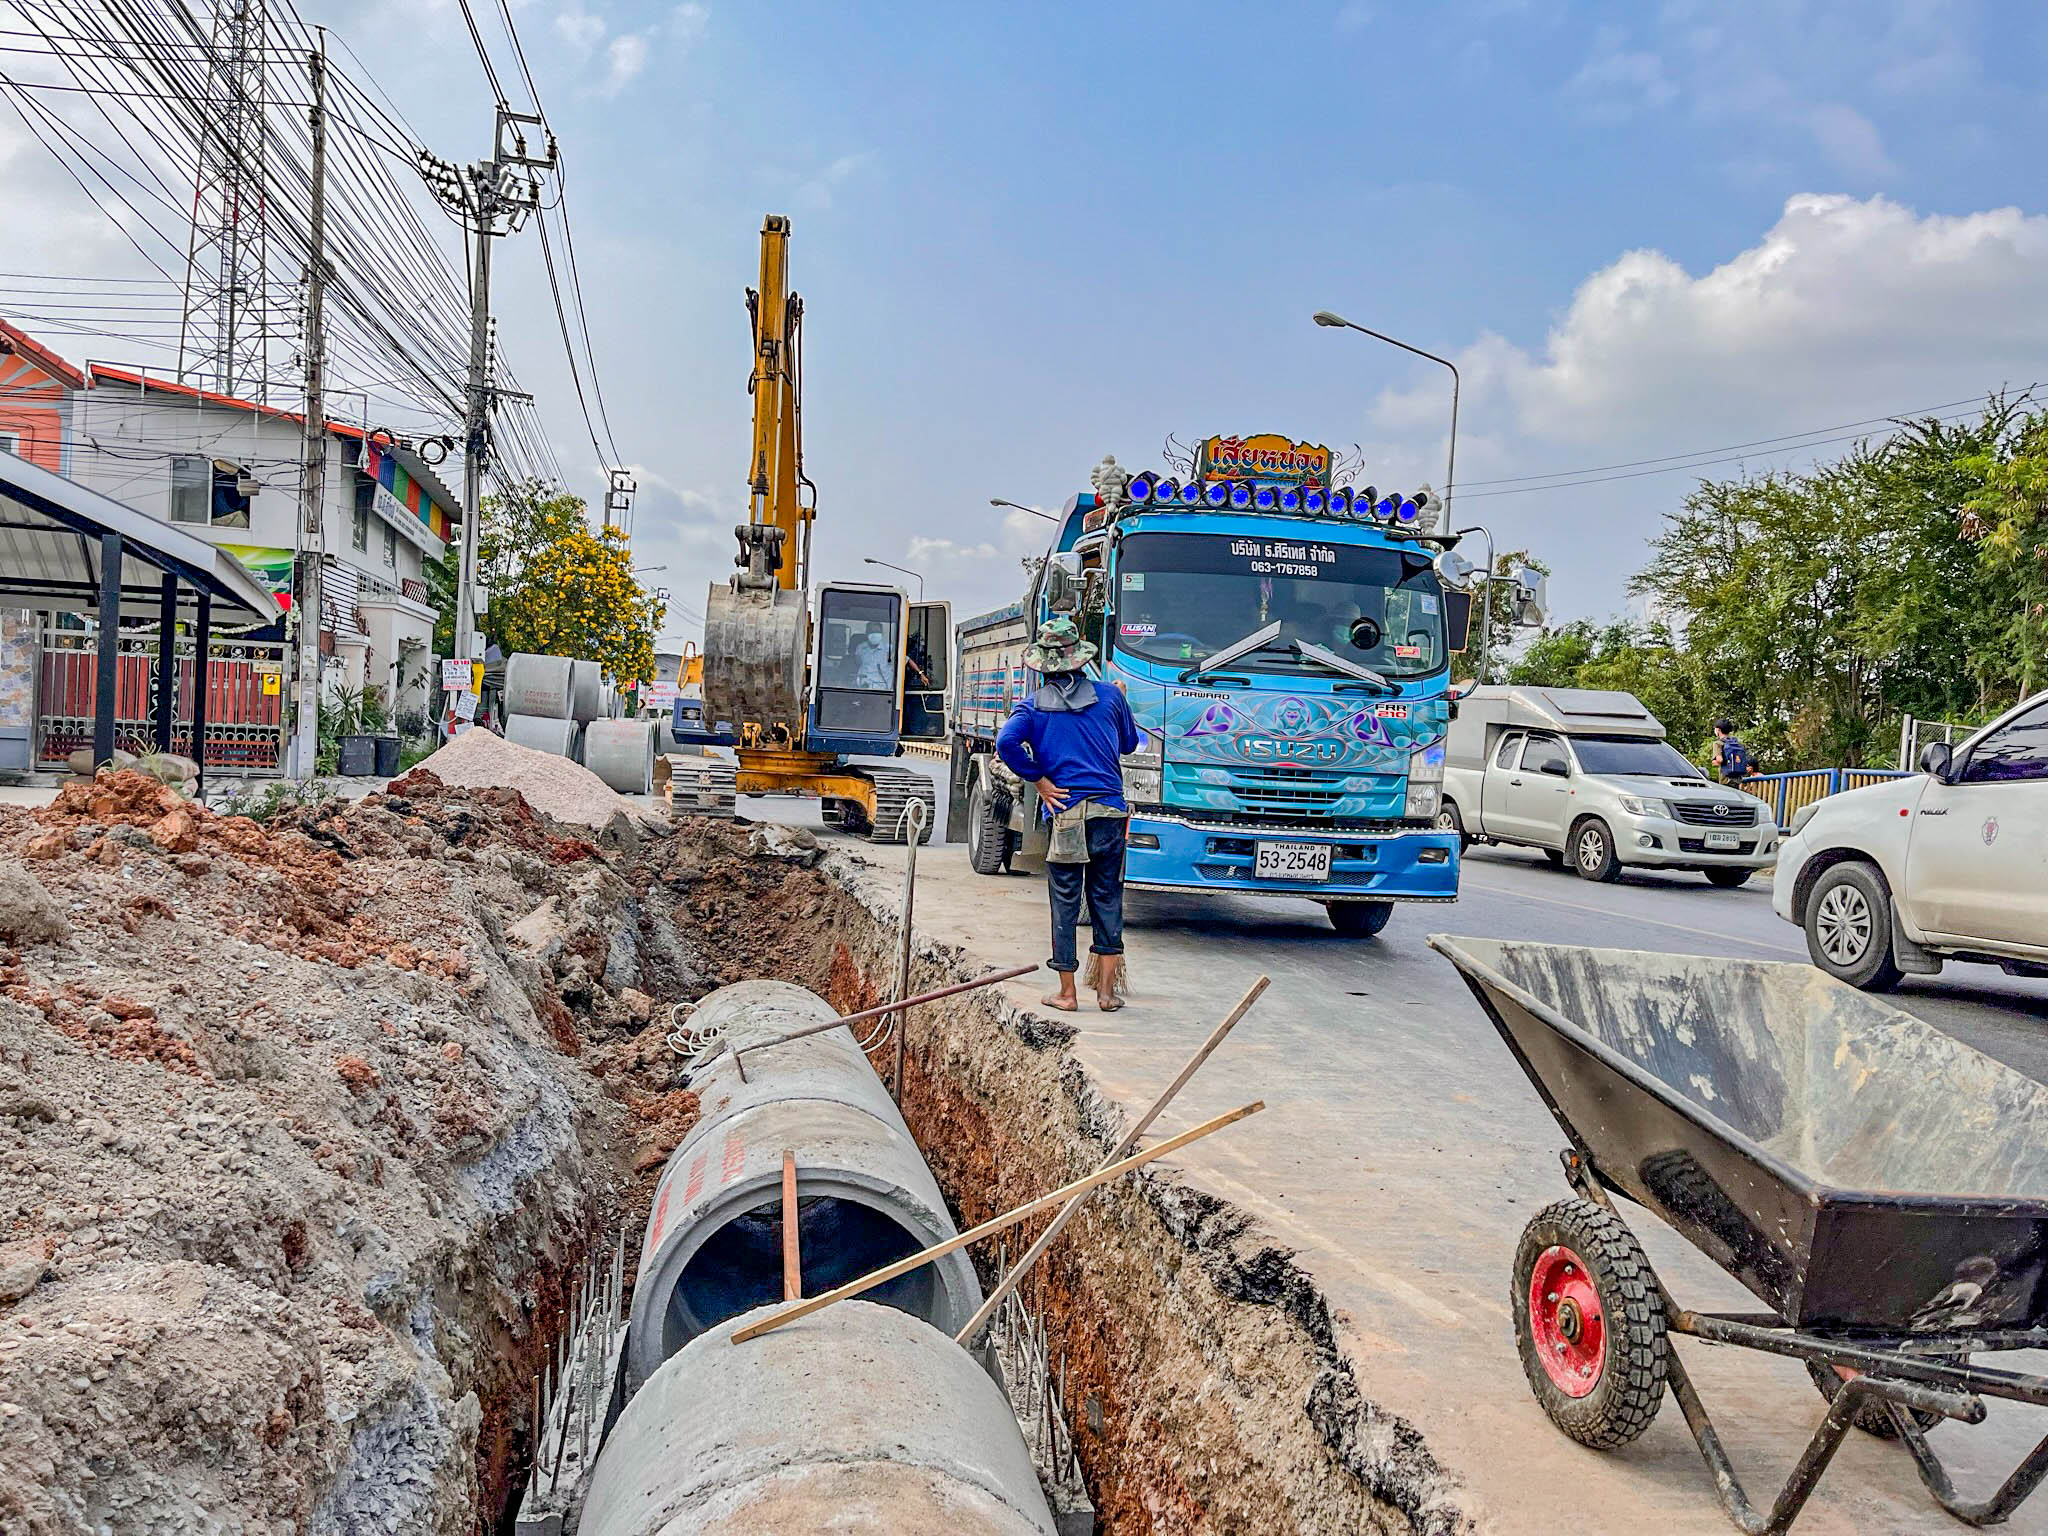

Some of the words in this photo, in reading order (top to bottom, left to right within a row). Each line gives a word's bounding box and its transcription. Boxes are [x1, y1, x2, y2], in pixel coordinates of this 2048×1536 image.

[1230, 539, 1261, 557] บริษัท
[1309, 544, 1336, 563] จำกัด
[1251, 561, 1318, 577] 063-1767858
[1173, 690, 1230, 700] FORWARD
[1375, 703, 1407, 712] FRR
[1375, 710, 1407, 718] 210
[1243, 739, 1337, 760] ISUZU
[1274, 843, 1316, 851] THAILAND
[1259, 850, 1327, 871] 53-2548
